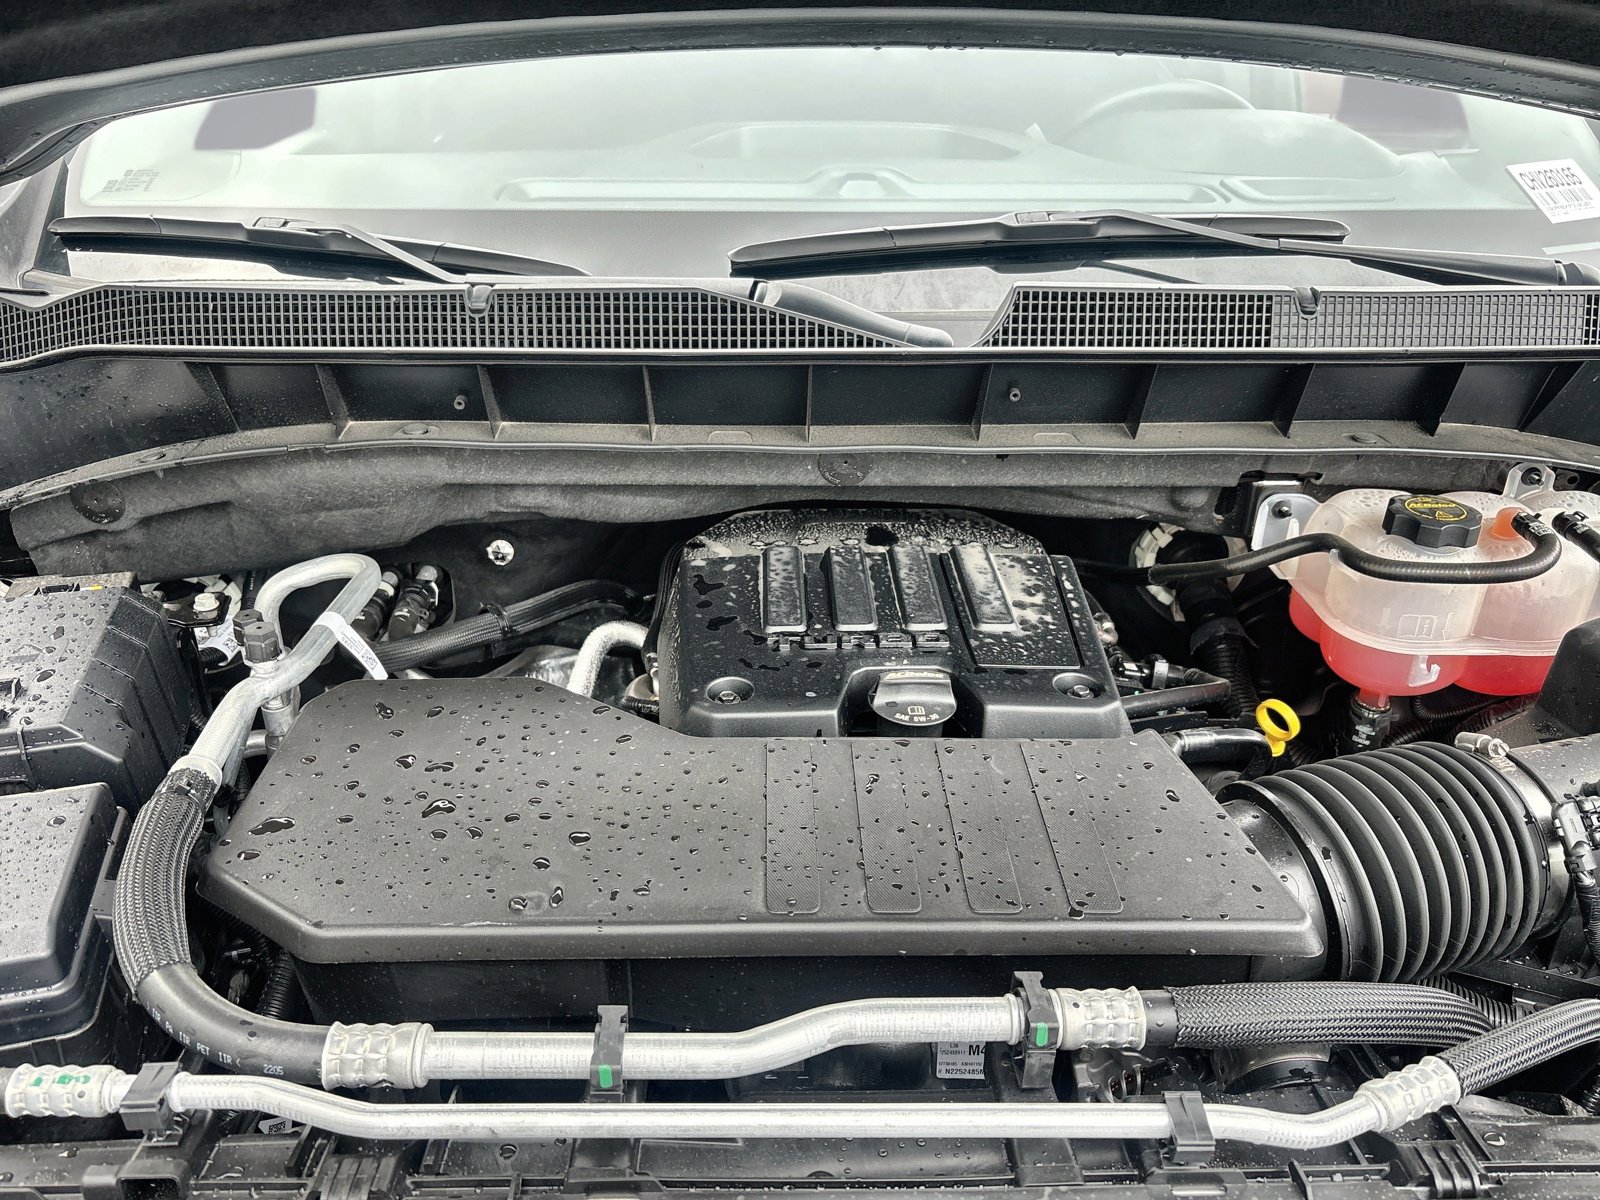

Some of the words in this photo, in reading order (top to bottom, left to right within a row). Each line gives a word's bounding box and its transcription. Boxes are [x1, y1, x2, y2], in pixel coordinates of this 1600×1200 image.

[1518, 166, 1583, 191] CHV260165
[767, 632, 950, 651] TURBO
[883, 671, 945, 680] ACDelco
[894, 712, 911, 721] SAE
[913, 713, 940, 722] 5W-30
[165, 1021, 174, 1034] PA
[178, 1031, 191, 1046] IIR
[196, 1042, 210, 1056] PET
[263, 1063, 284, 1076] 2205
